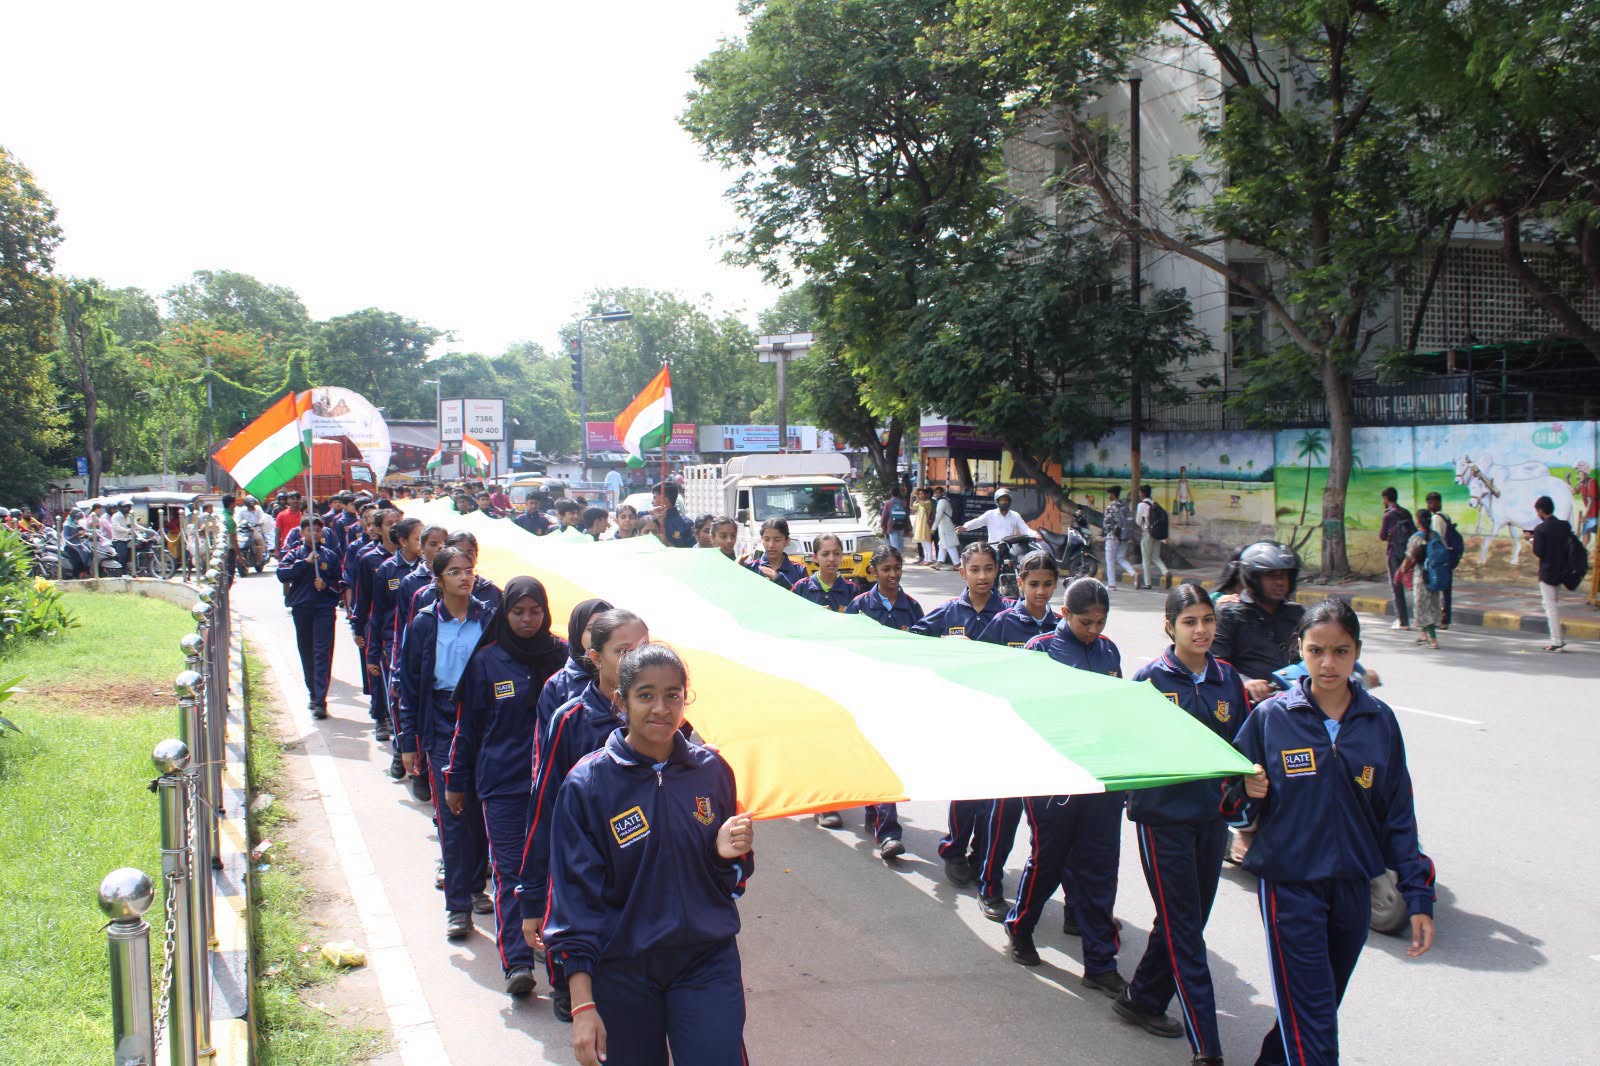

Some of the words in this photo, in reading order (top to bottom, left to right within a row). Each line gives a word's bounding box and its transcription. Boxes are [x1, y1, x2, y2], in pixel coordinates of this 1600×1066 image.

[1392, 392, 1468, 421] AGRICULTURE
[1533, 432, 1562, 445] GHMC
[1285, 754, 1310, 764] SLATE
[615, 813, 641, 833] SLATE
